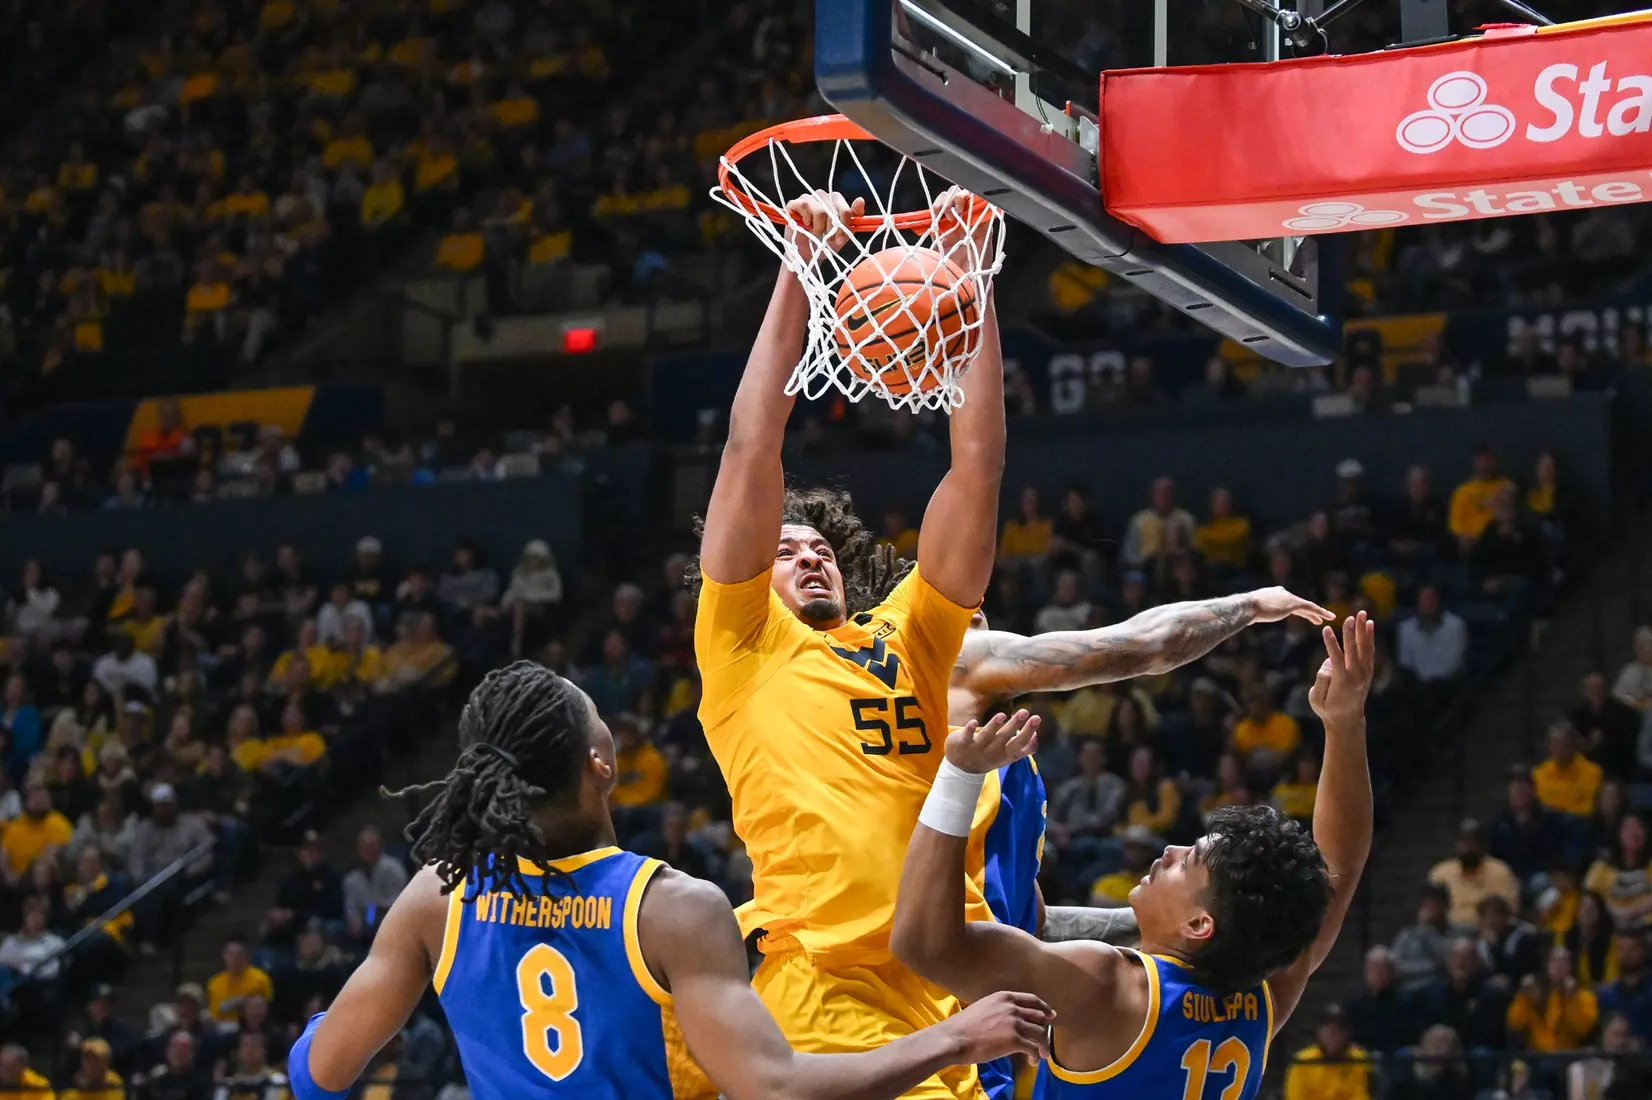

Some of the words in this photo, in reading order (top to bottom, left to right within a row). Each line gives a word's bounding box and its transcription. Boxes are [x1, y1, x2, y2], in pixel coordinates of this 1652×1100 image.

[1526, 60, 1652, 142] Sta
[1413, 181, 1644, 219] State
[850, 696, 932, 755] 55
[475, 890, 612, 929] WITHERSPOON
[516, 943, 584, 1082] 8
